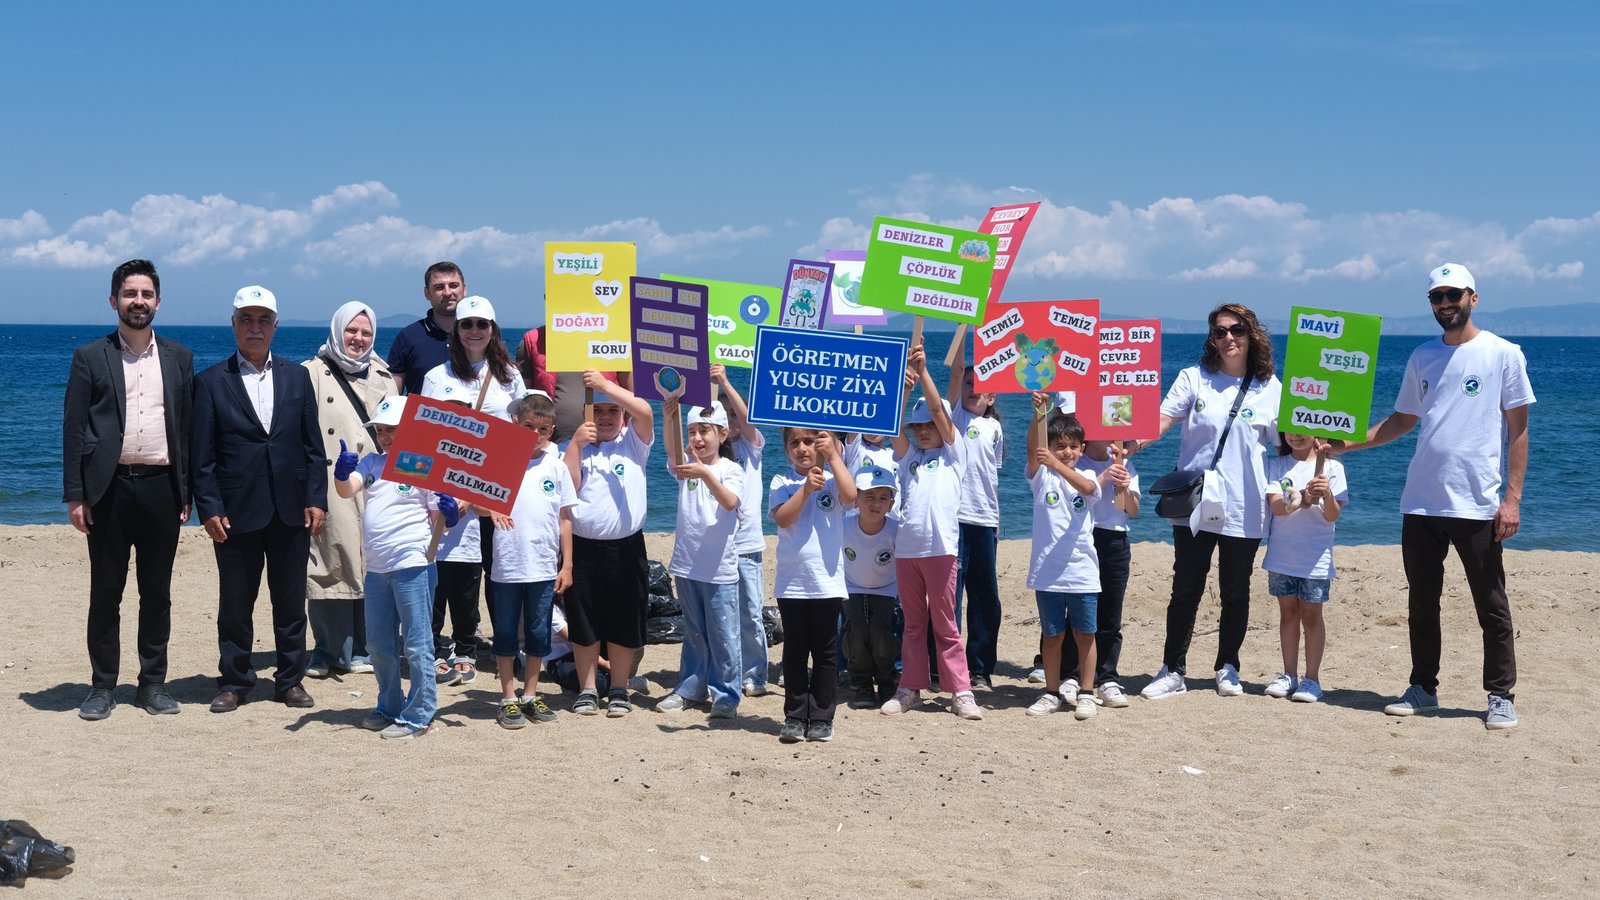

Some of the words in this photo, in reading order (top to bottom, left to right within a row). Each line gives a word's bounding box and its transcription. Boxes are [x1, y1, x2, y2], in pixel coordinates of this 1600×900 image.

[993, 224, 1011, 233] HOR
[884, 228, 944, 248] DENİZLER
[557, 256, 599, 272] YEŞİLİ
[906, 260, 957, 281] ÇÖPLÜK
[594, 285, 619, 297] SEV
[913, 293, 973, 312] DEĞİLDİR
[555, 314, 605, 328] DOĞAYI
[982, 313, 1021, 339] TEMİZ
[1053, 309, 1093, 332] TEMİZ
[1301, 318, 1340, 334] MAVİ
[638, 332, 671, 346] UMUT
[1099, 330, 1121, 341] MİZ
[1131, 329, 1151, 340] BİR
[591, 343, 628, 355] KORU
[772, 343, 889, 374] ÖĞRETMEN
[979, 348, 1016, 376] BIRAK
[1062, 355, 1088, 373] BUL
[1100, 352, 1137, 364] ÇEVRE
[1324, 353, 1365, 369] YEŞİL
[769, 369, 837, 392] YUSUF
[842, 374, 887, 397] ZİYA
[1115, 374, 1130, 383] EL
[1135, 374, 1156, 383] ELE
[1295, 381, 1324, 395] KAL
[774, 390, 878, 420] İLKOKULU
[420, 407, 486, 435] DENİZLER
[1295, 411, 1351, 428] YALOVA
[440, 440, 483, 464] TEMİZ
[446, 471, 508, 500] KALMALI
